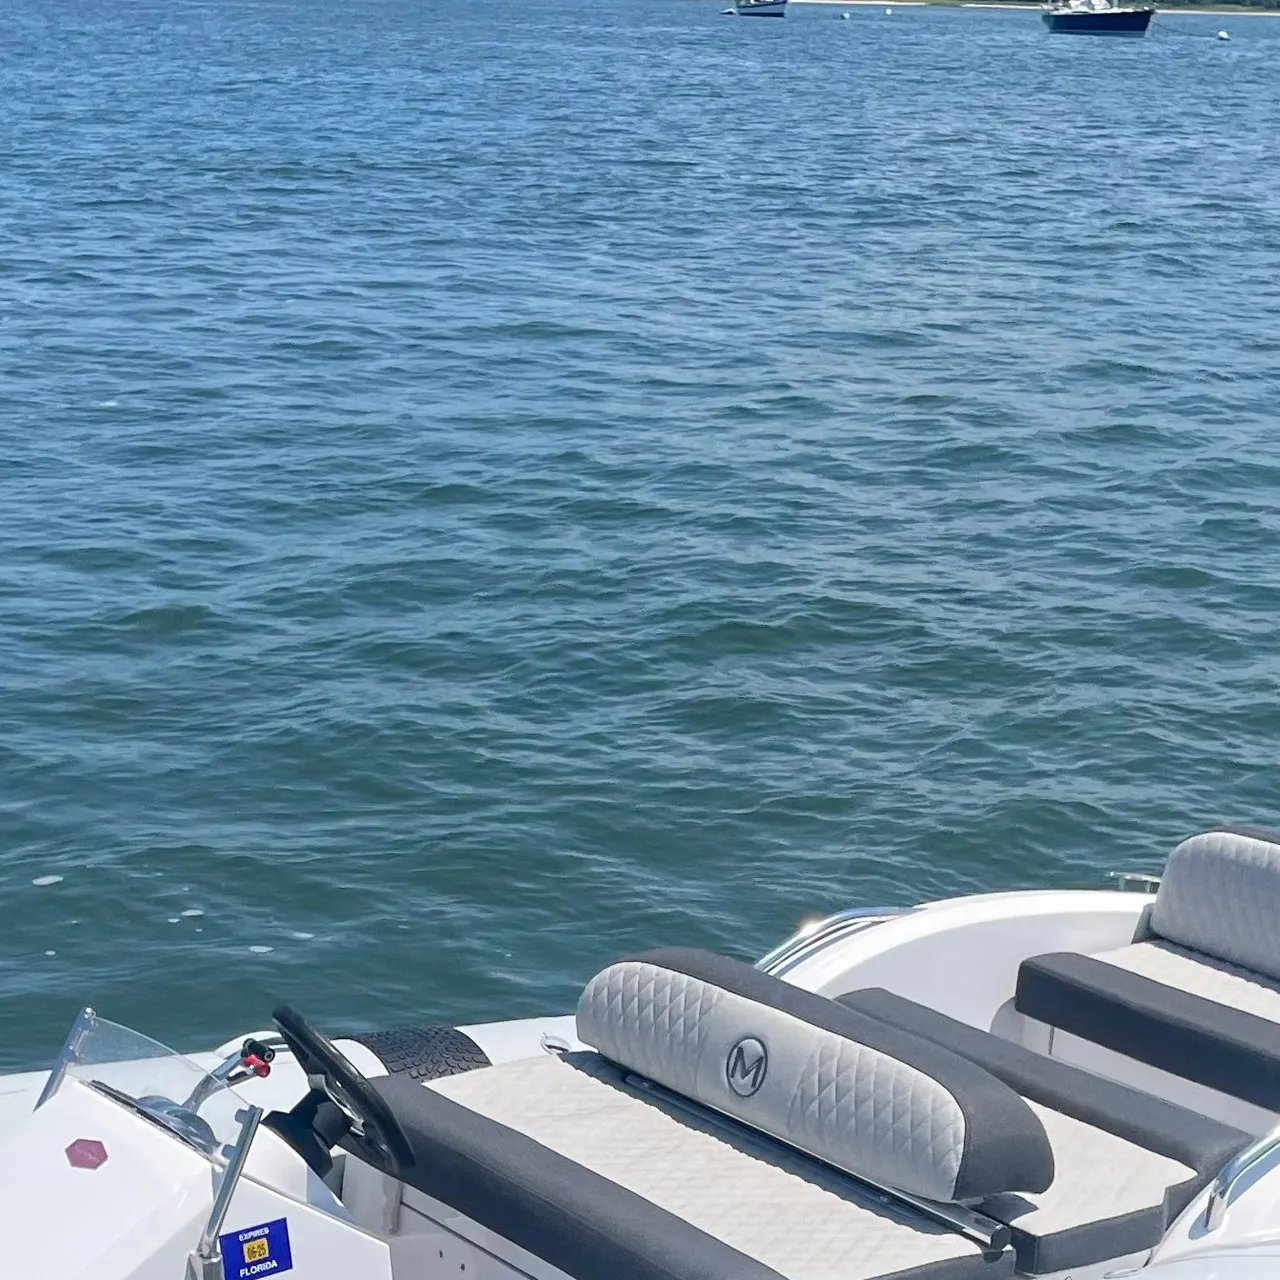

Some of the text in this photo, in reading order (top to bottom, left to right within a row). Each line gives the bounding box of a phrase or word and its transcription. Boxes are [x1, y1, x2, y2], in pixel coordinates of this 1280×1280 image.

[729, 1045, 765, 1089] M
[239, 1226, 270, 1242] EXPIRES
[239, 1259, 278, 1278] FLORIDA
